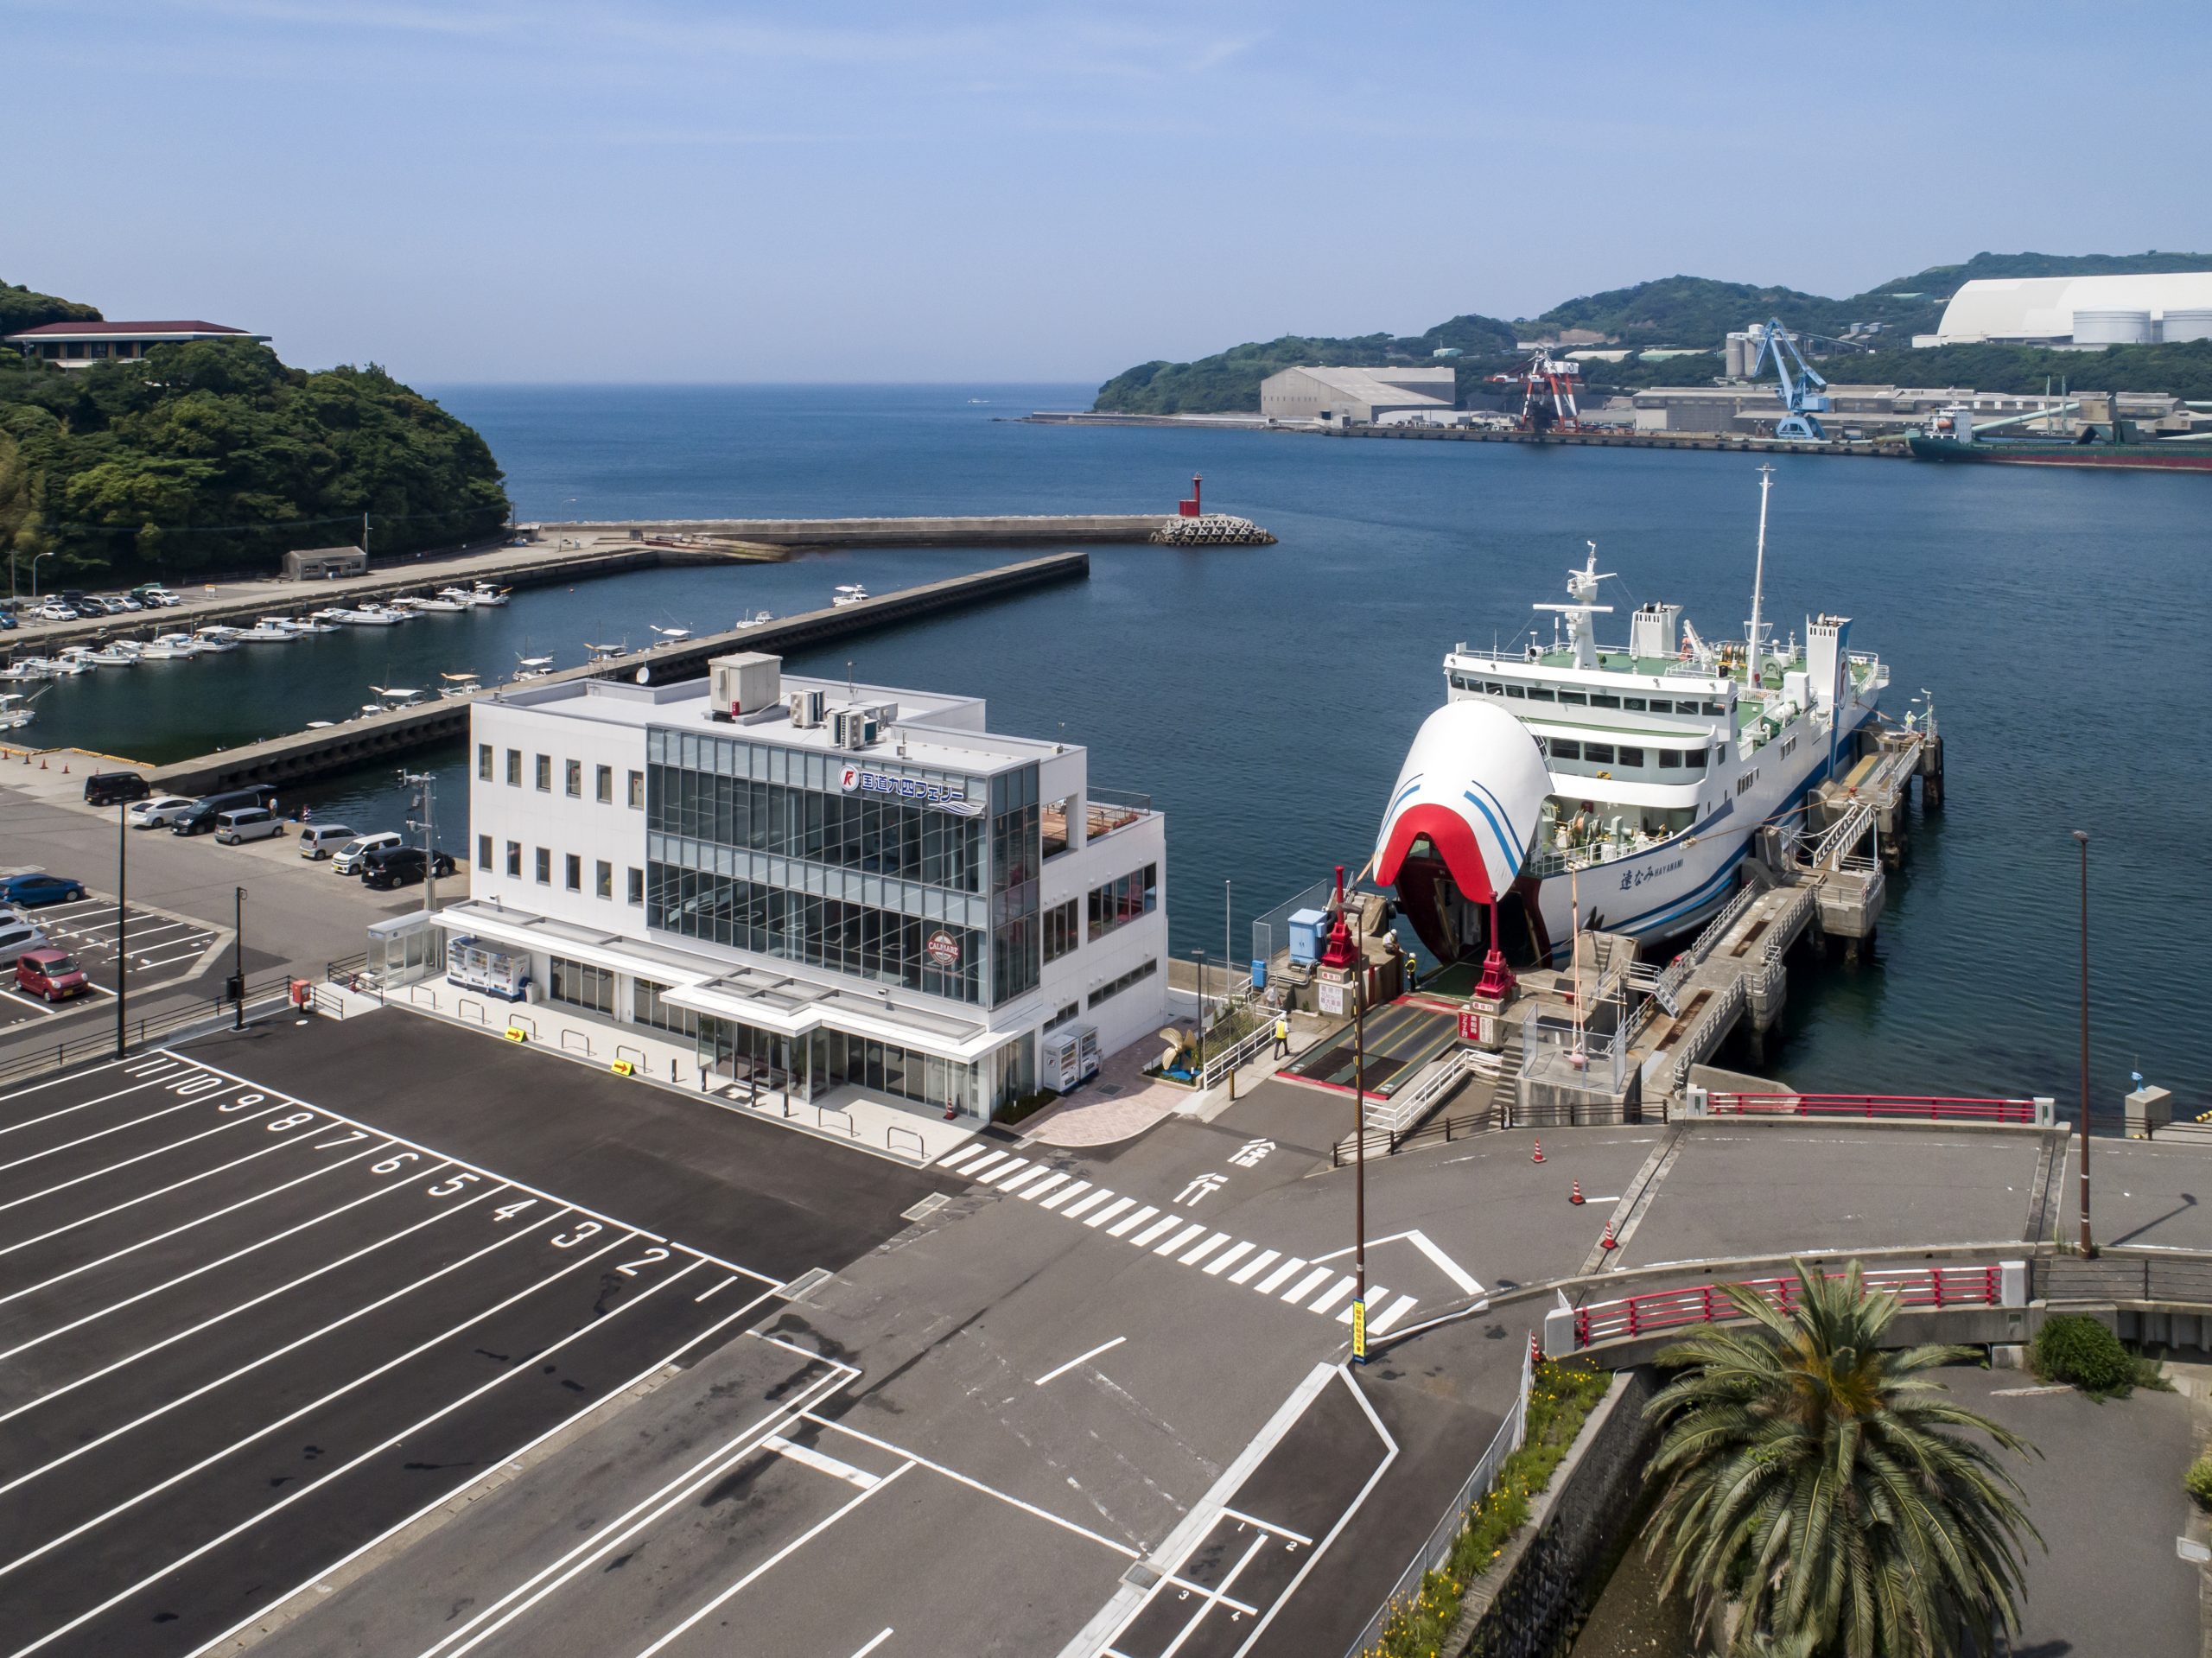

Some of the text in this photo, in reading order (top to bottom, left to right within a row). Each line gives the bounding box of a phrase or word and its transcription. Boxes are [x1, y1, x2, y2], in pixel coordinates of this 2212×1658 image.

[861, 771, 964, 802] 国道九四フェリー
[1654, 858, 1684, 877] HAYANAMI
[164, 1073, 223, 1096] 10
[218, 1094, 265, 1113] 9
[266, 1112, 315, 1132] 8
[314, 1130, 369, 1150] 7
[371, 1152, 420, 1174] 6
[427, 1172, 481, 1197] 5
[493, 1198, 538, 1222] 4
[550, 1221, 603, 1248] 3
[615, 1248, 670, 1277] 2
[1286, 1541, 1298, 1552] 2
[1179, 1591, 1190, 1600] 3
[1231, 1611, 1241, 1622] 4
